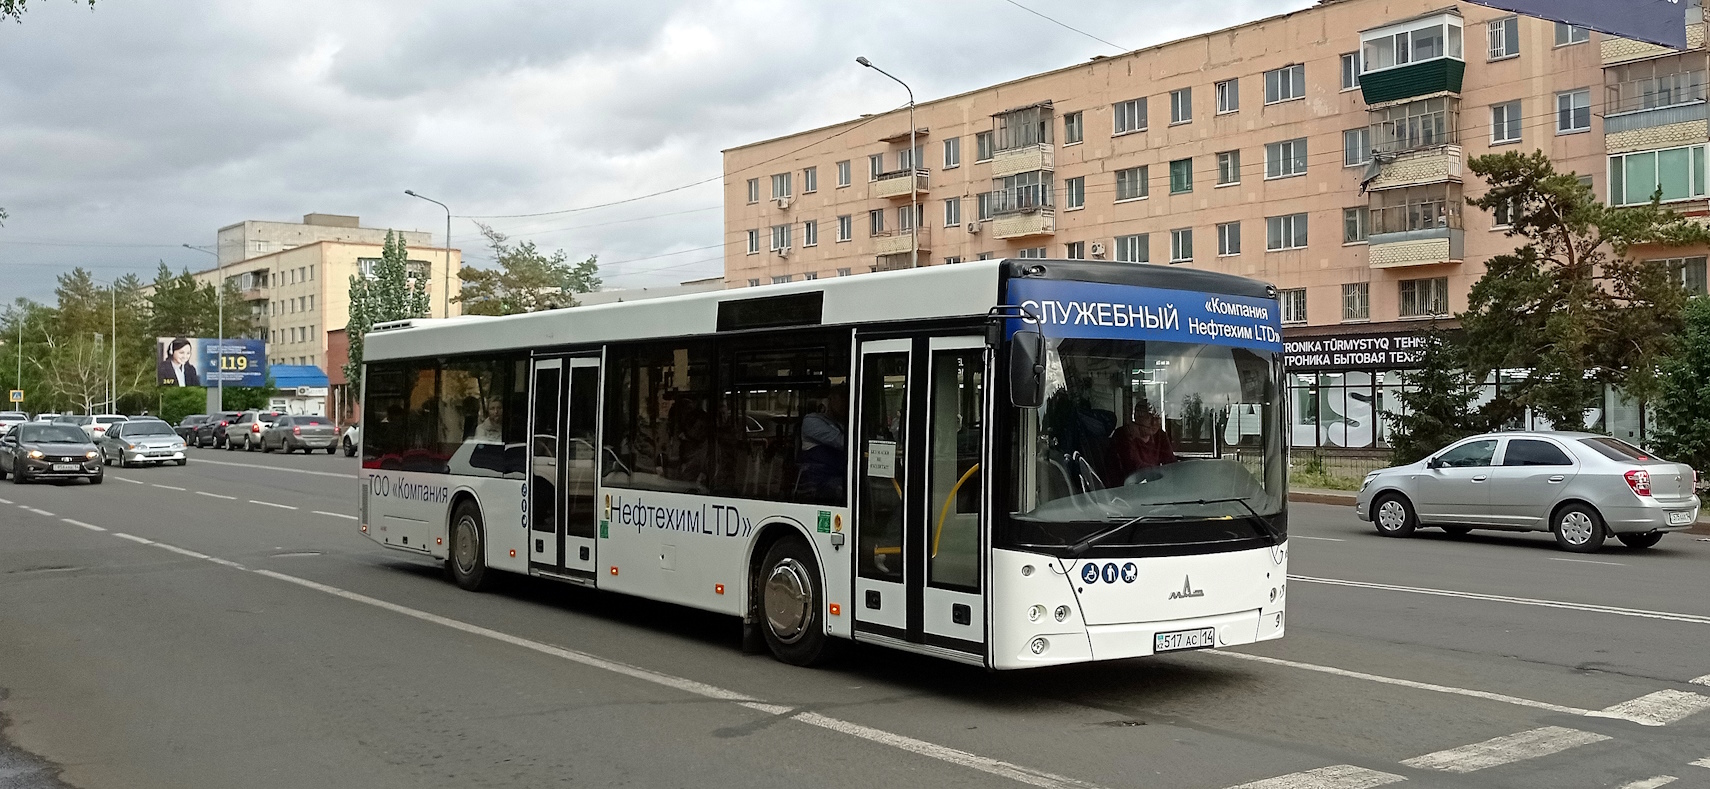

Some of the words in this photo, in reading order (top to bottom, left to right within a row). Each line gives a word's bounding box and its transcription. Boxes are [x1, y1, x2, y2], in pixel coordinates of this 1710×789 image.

[1019, 299, 1180, 331] СЛУЖЕБНЫЙ
[1204, 297, 1269, 320] «Компания
[1188, 317, 1253, 340] Нефтехим
[1254, 324, 1281, 344] LTD»
[1283, 341, 1322, 353] RONIKA
[1333, 351, 1386, 365] БЫТОВАЯ
[221, 356, 247, 371] 119
[369, 474, 390, 497] ТОО
[393, 477, 448, 503] «Компания
[610, 495, 699, 534] Нефтехим
[702, 503, 752, 538] LTD»
[1164, 633, 1182, 648] 517
[1202, 630, 1213, 644] 14
